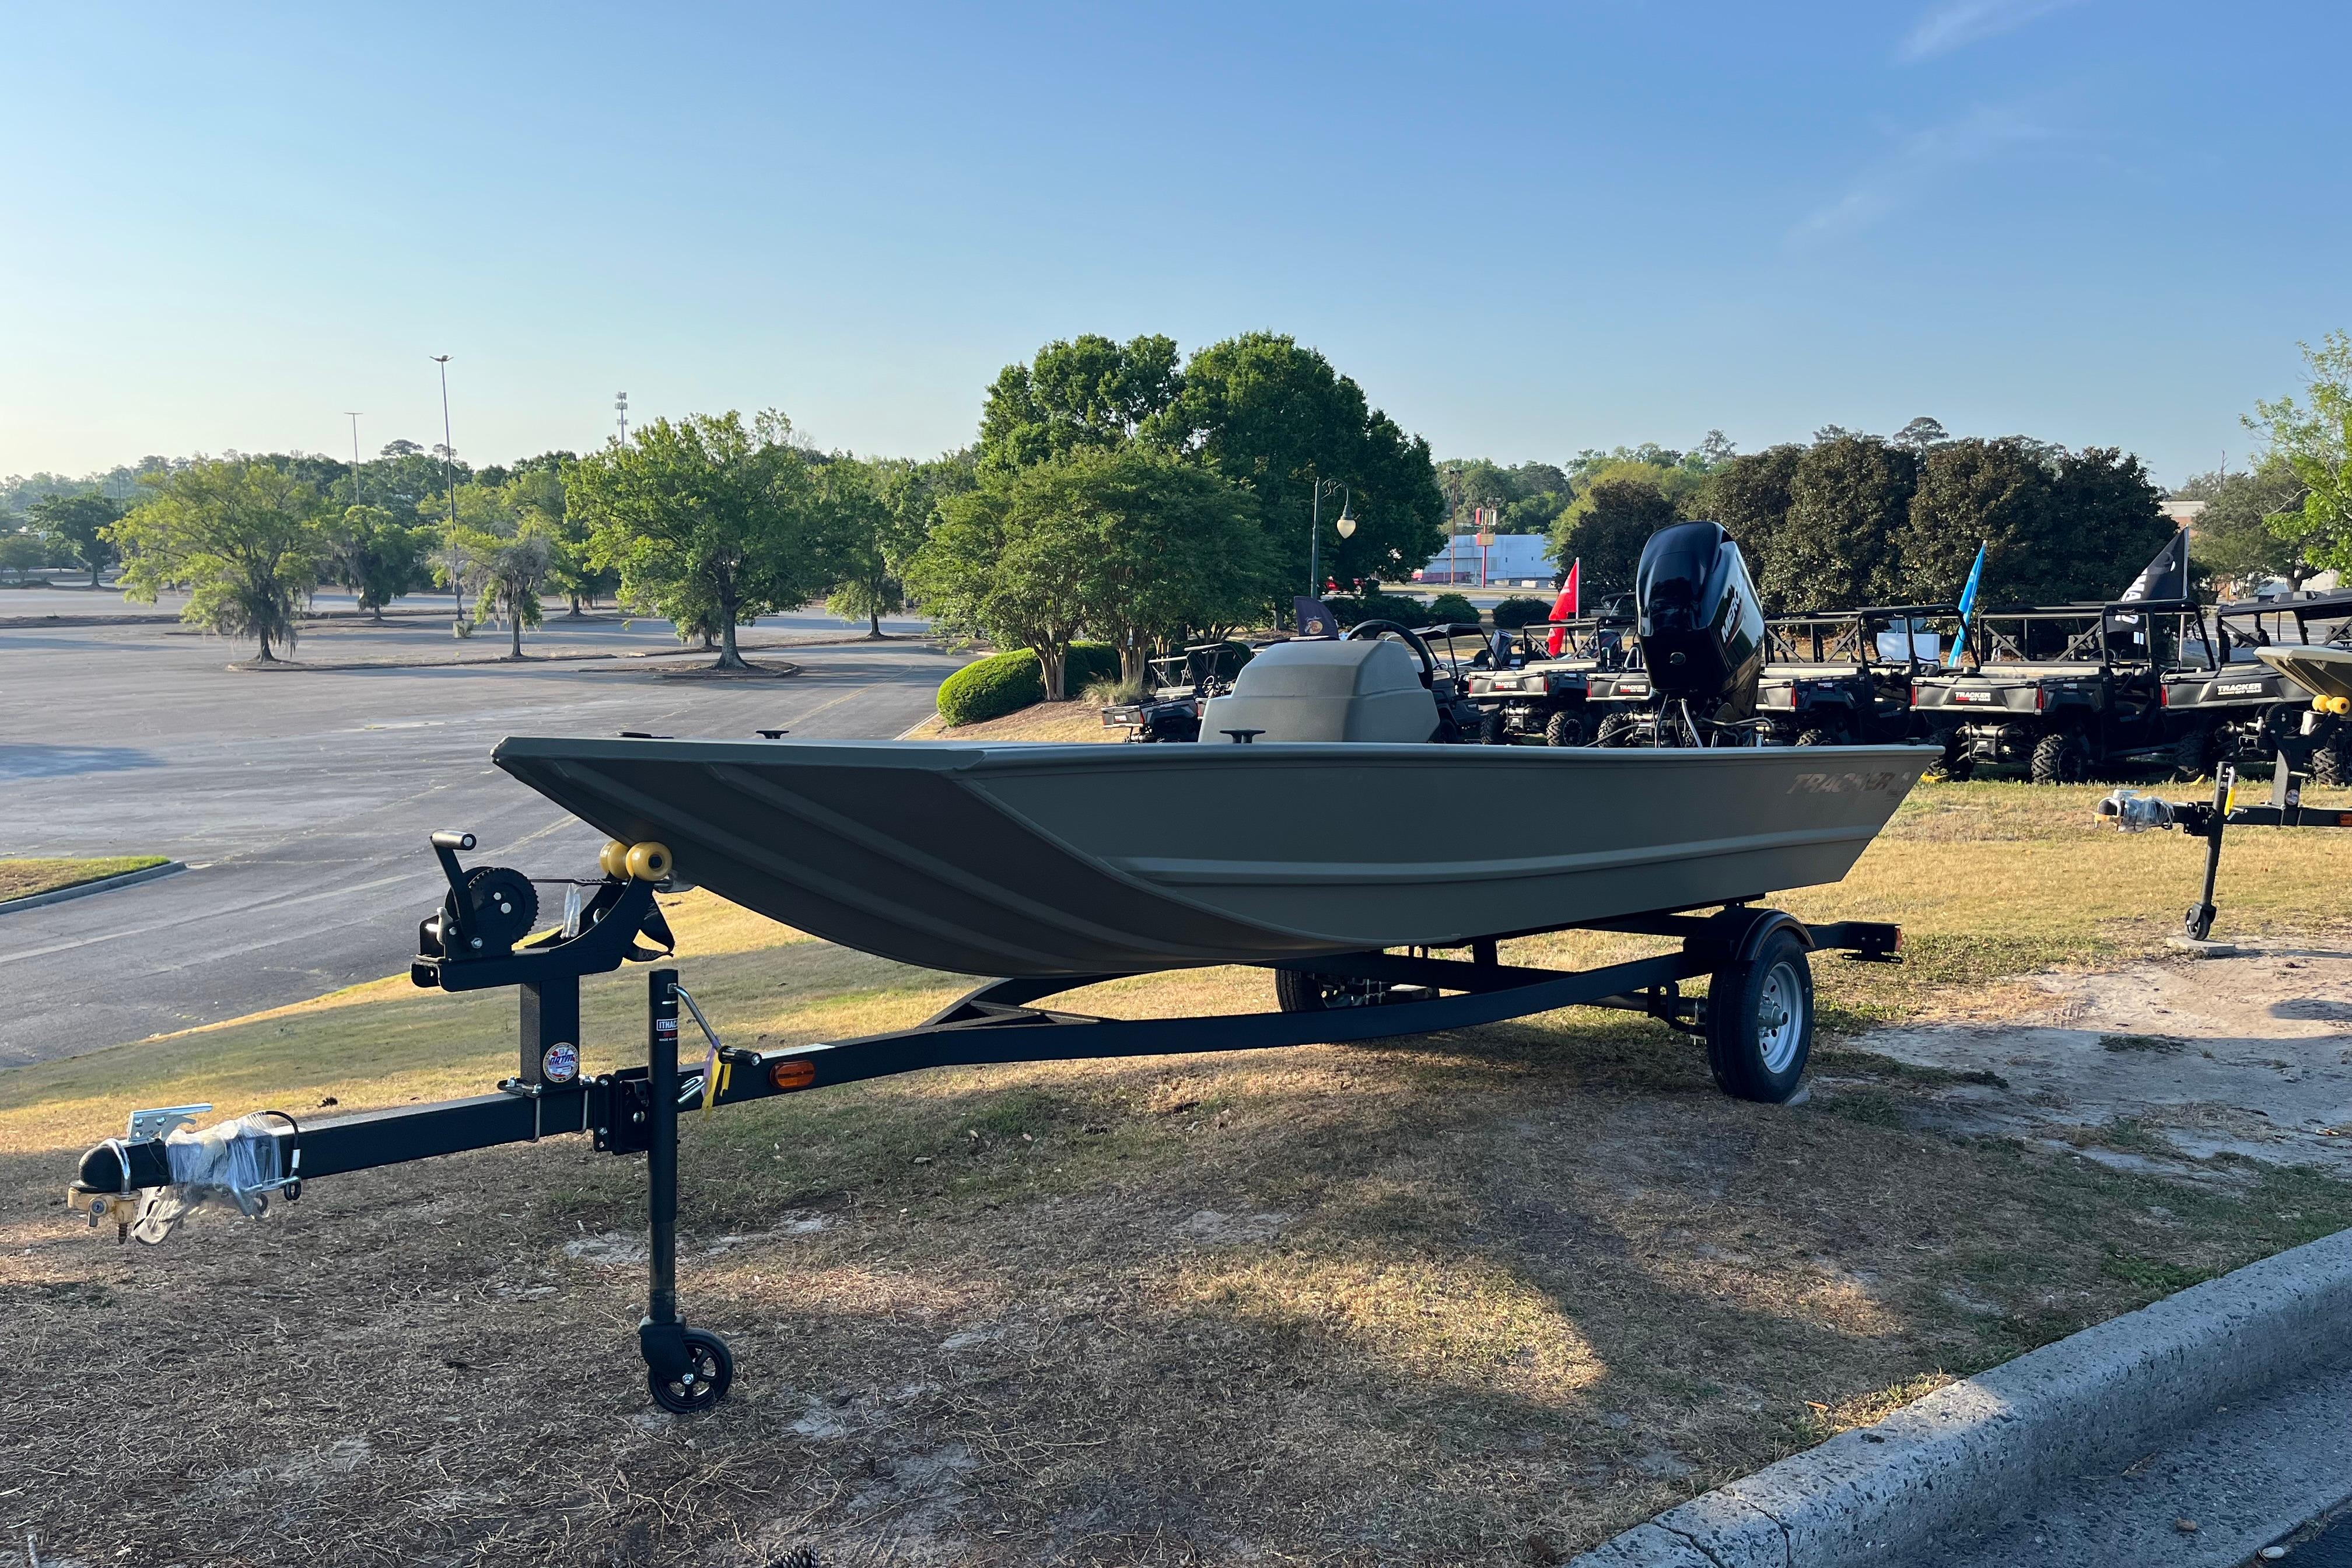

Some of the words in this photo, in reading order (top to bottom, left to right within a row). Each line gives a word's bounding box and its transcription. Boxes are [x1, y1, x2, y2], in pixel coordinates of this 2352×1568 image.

[1721, 565, 1743, 643] MERCU
[2217, 682, 2262, 692] TRACKER
[659, 1020, 678, 1030] ITHAC
